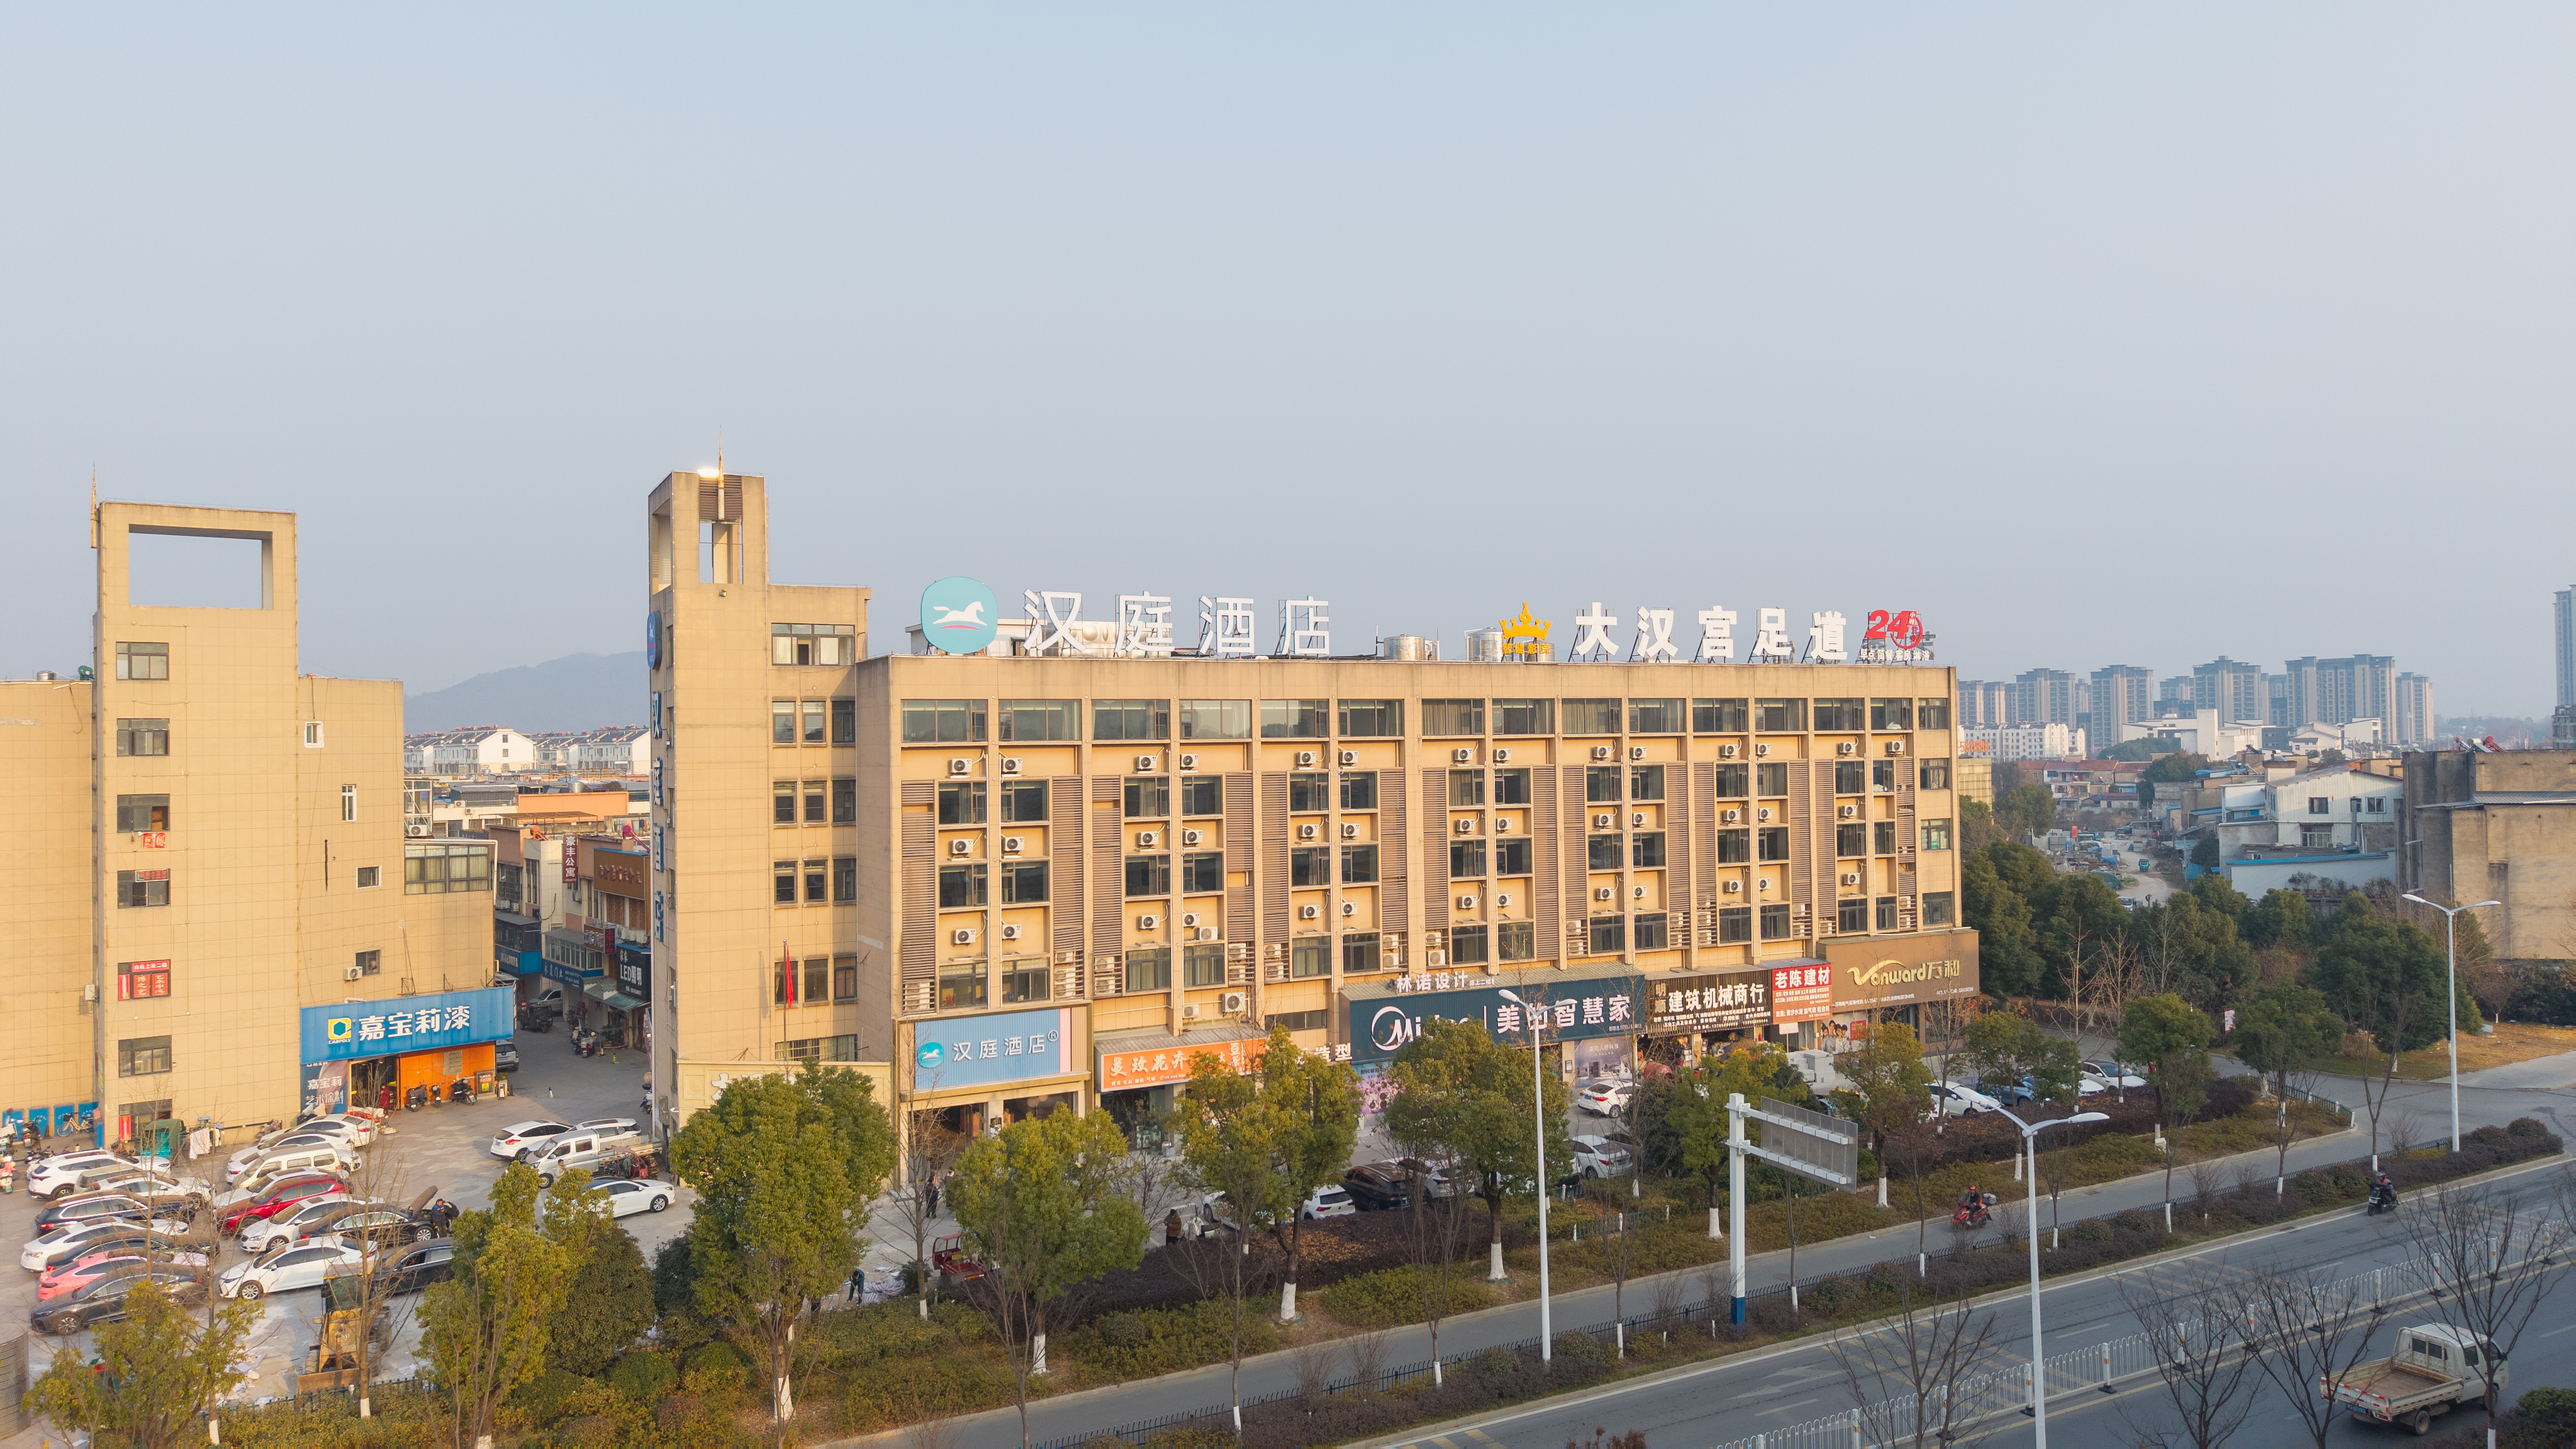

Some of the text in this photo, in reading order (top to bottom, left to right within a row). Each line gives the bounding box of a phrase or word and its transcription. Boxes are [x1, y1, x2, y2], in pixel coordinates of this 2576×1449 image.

[1022, 588, 1331, 655] 汉庭酒店
[1575, 602, 1848, 660] 大汉宫足道
[1865, 609, 1914, 640] 24
[1909, 611, 1916, 625] 小时
[1502, 642, 1550, 655] 智能影院
[565, 836, 576, 877] 豪丰公寓
[620, 964, 642, 986] LED照明
[1397, 970, 1468, 993] 林诺设计
[1775, 967, 1830, 989] 老陈建材
[1668, 983, 1765, 1013] 建筑机械商行
[358, 1005, 470, 1041] 嘉宝莉漆
[1497, 994, 1631, 1035] 美的智慧家
[953, 1033, 1045, 1062] 汉庭酒店
[307, 1075, 342, 1090] 嘉宝莉
